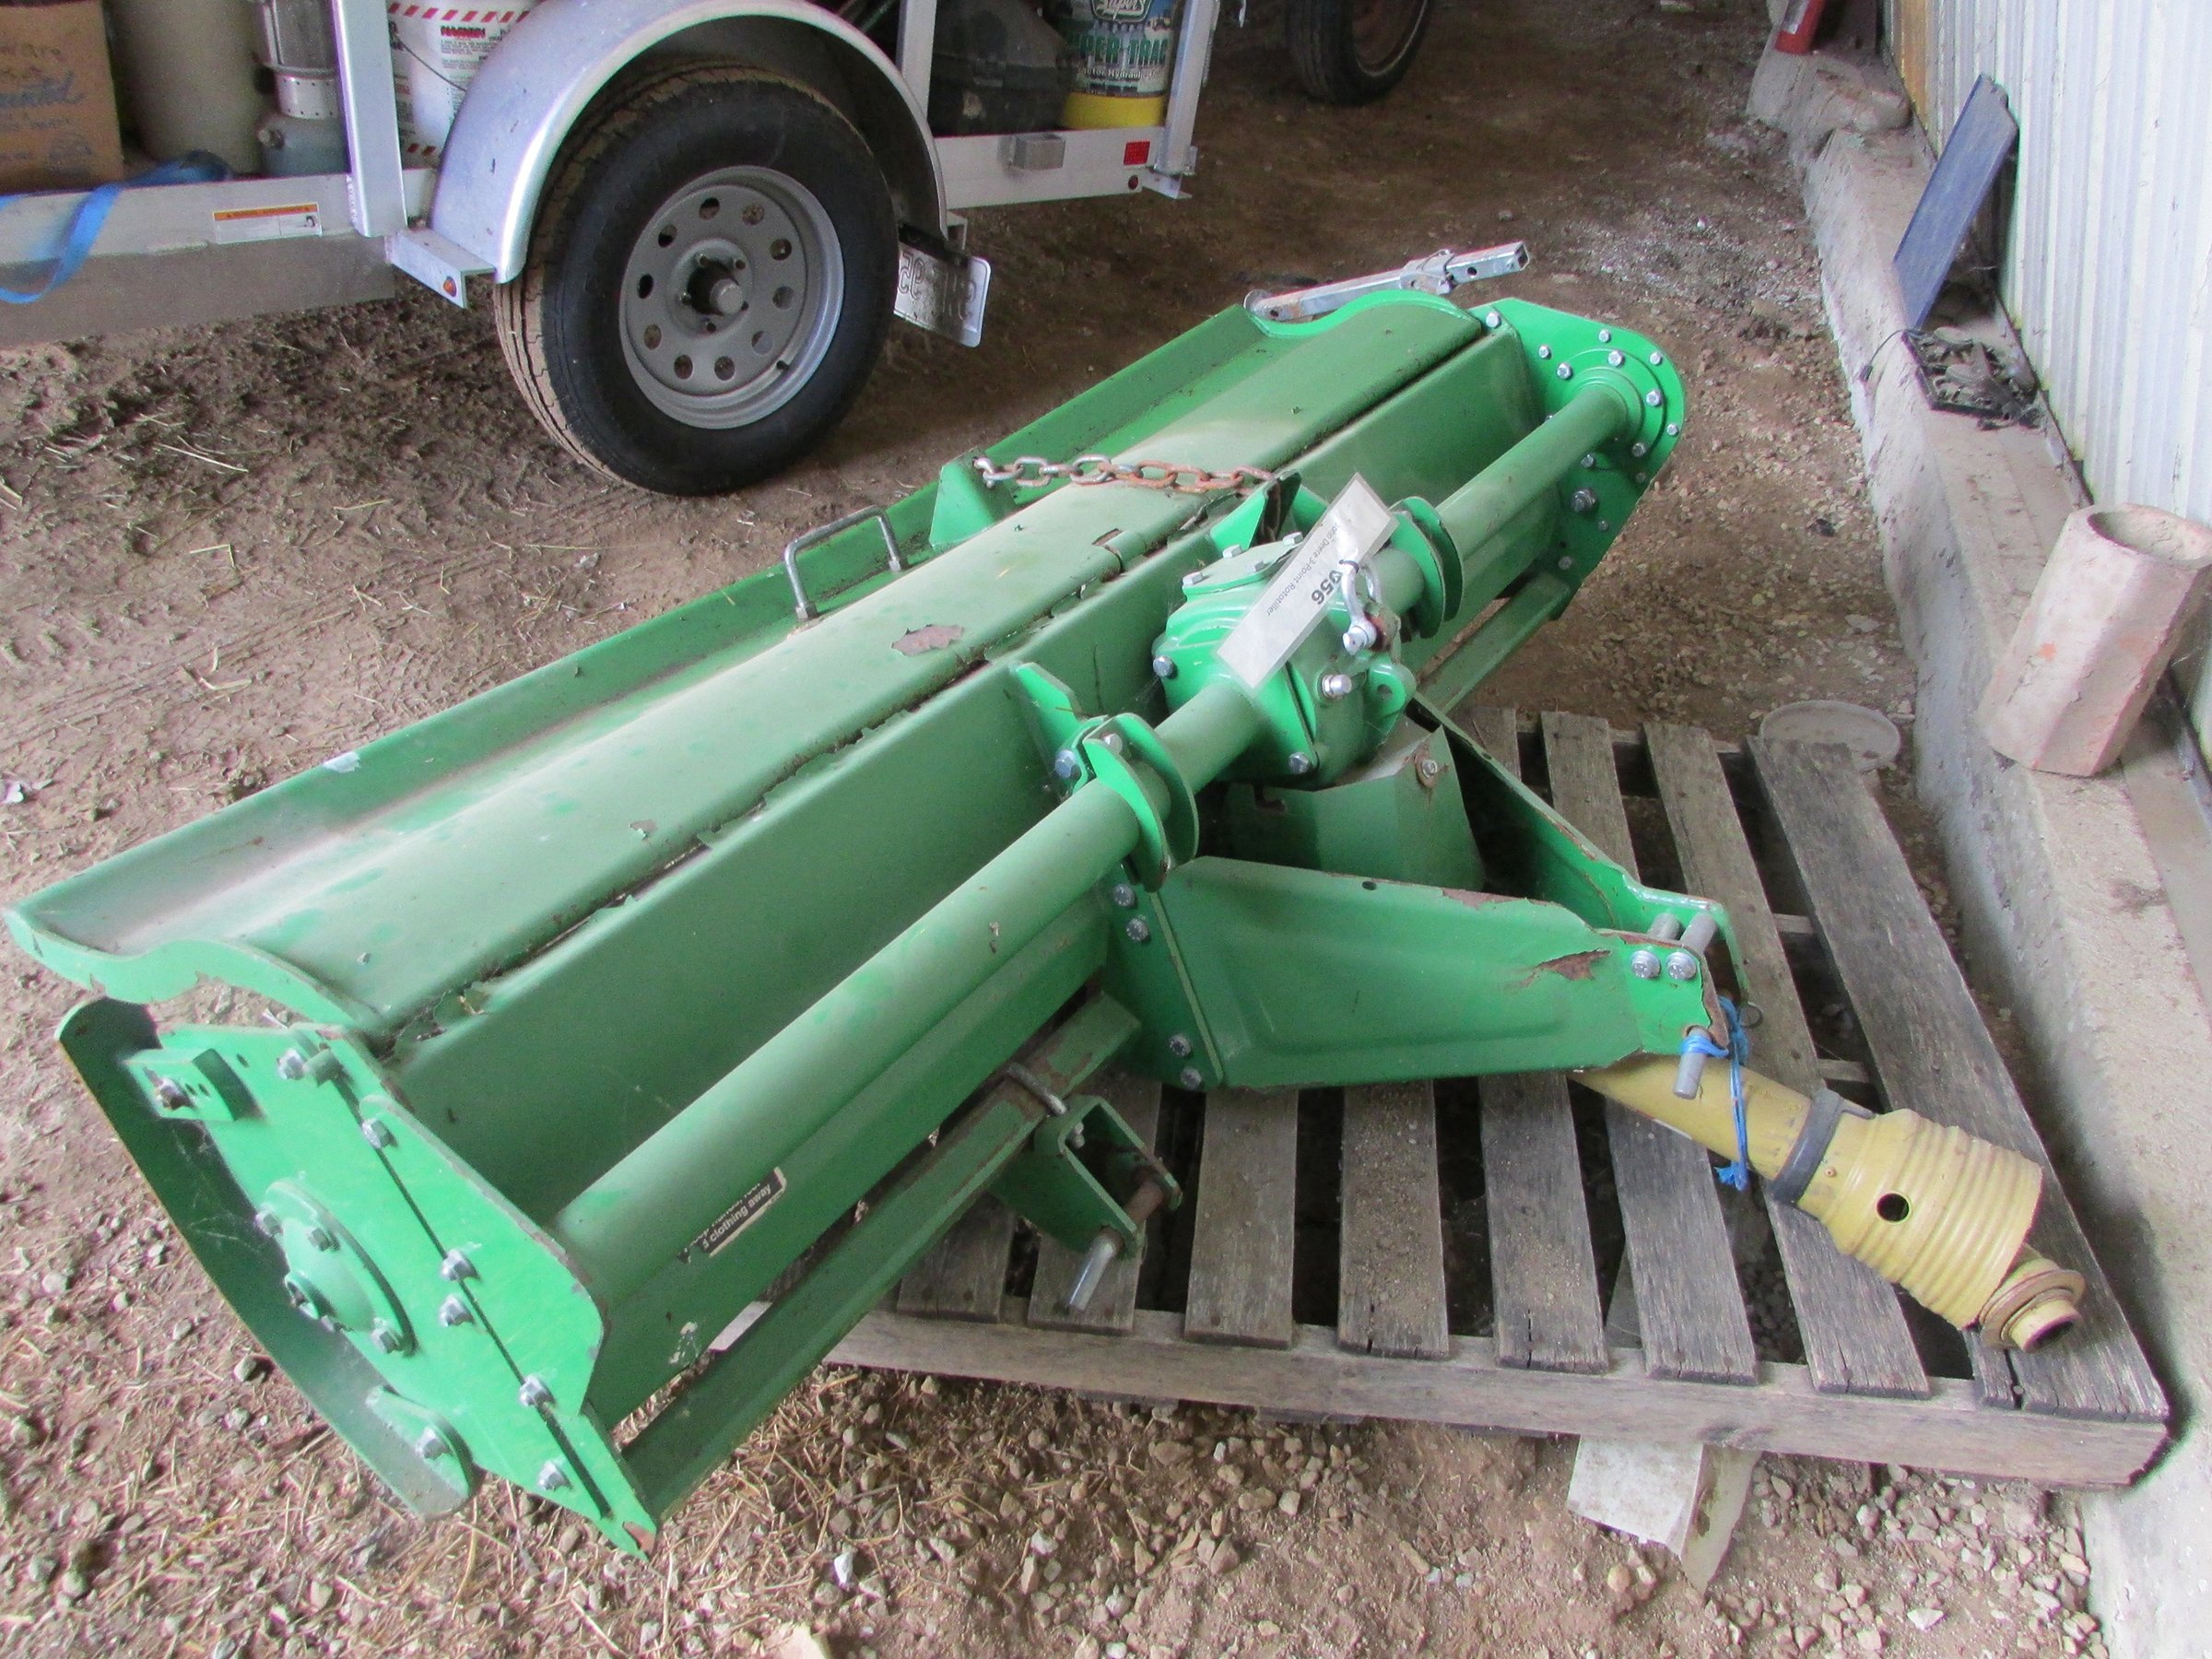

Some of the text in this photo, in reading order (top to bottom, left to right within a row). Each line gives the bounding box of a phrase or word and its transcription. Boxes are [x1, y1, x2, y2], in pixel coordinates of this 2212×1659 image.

[1312, 537, 1330, 559] Deere
[1266, 582, 1296, 617] Rototiller
[710, 1206, 748, 1242] clothing
[747, 1183, 771, 1208] away
